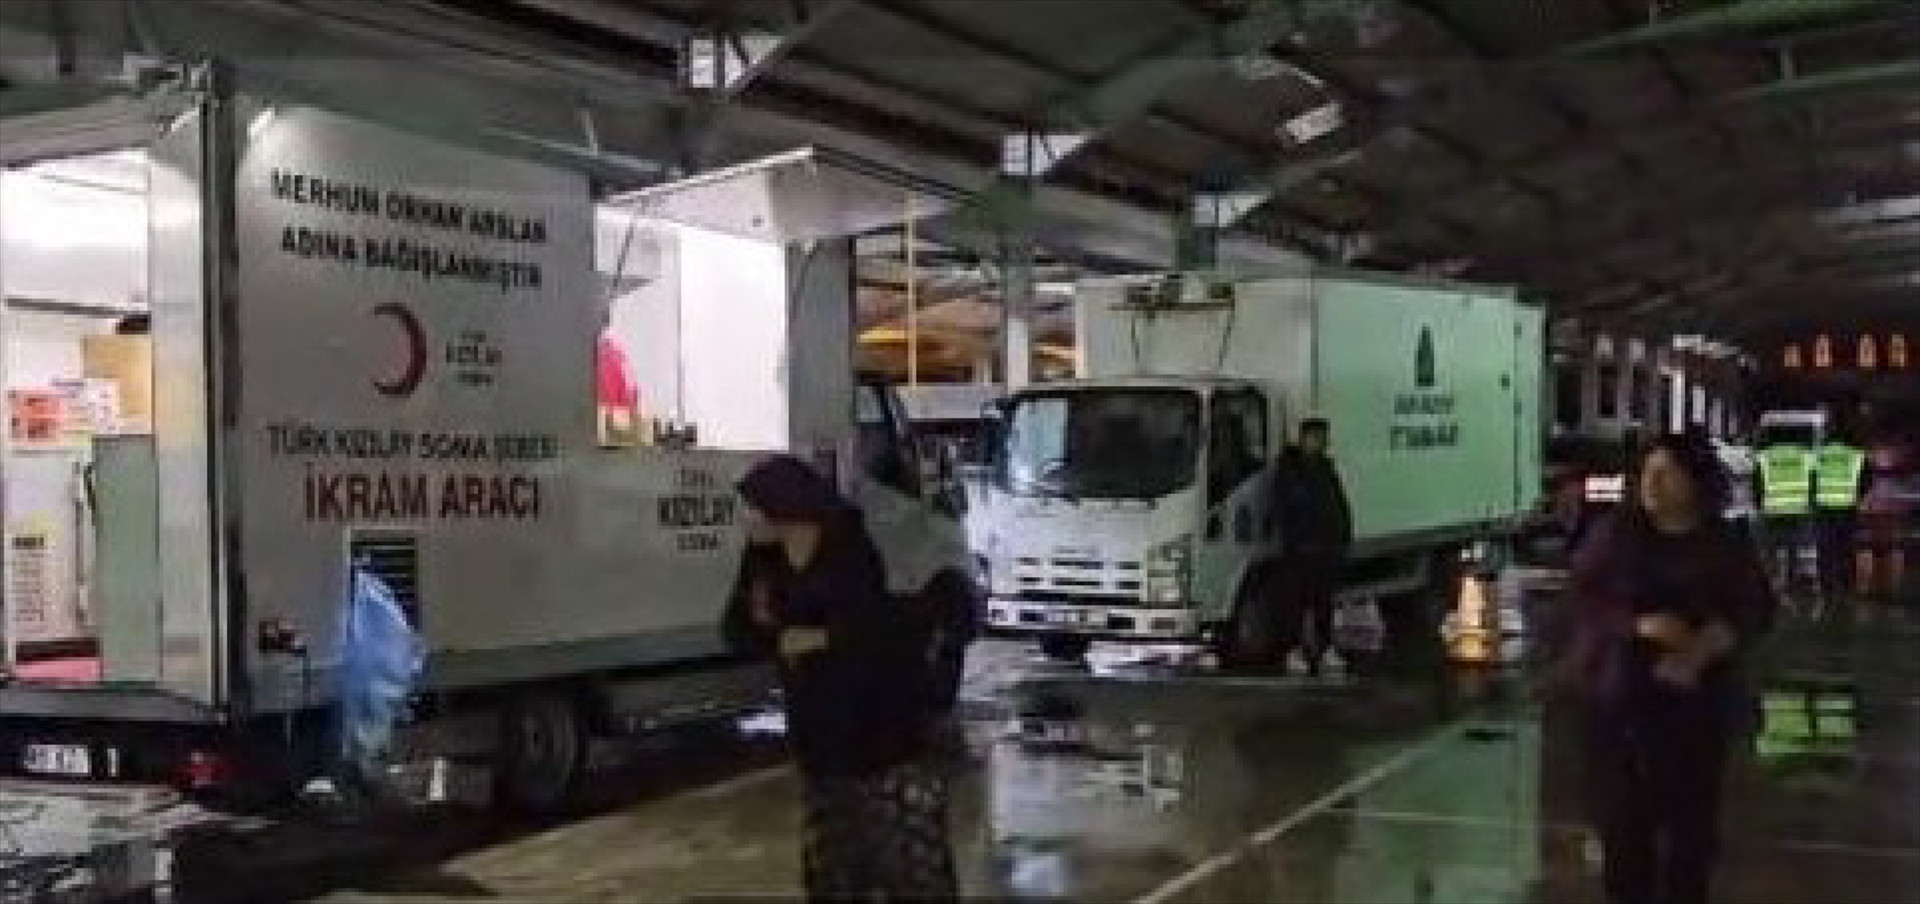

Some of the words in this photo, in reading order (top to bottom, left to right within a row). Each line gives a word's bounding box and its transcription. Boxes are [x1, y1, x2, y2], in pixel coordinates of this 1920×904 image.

[270, 167, 379, 216] MERHUM
[281, 226, 359, 260] ADINA
[267, 420, 331, 459] TÜRK
[418, 430, 487, 460] SOMA
[304, 462, 429, 523] İKRAM
[437, 474, 541, 521] ARACI
